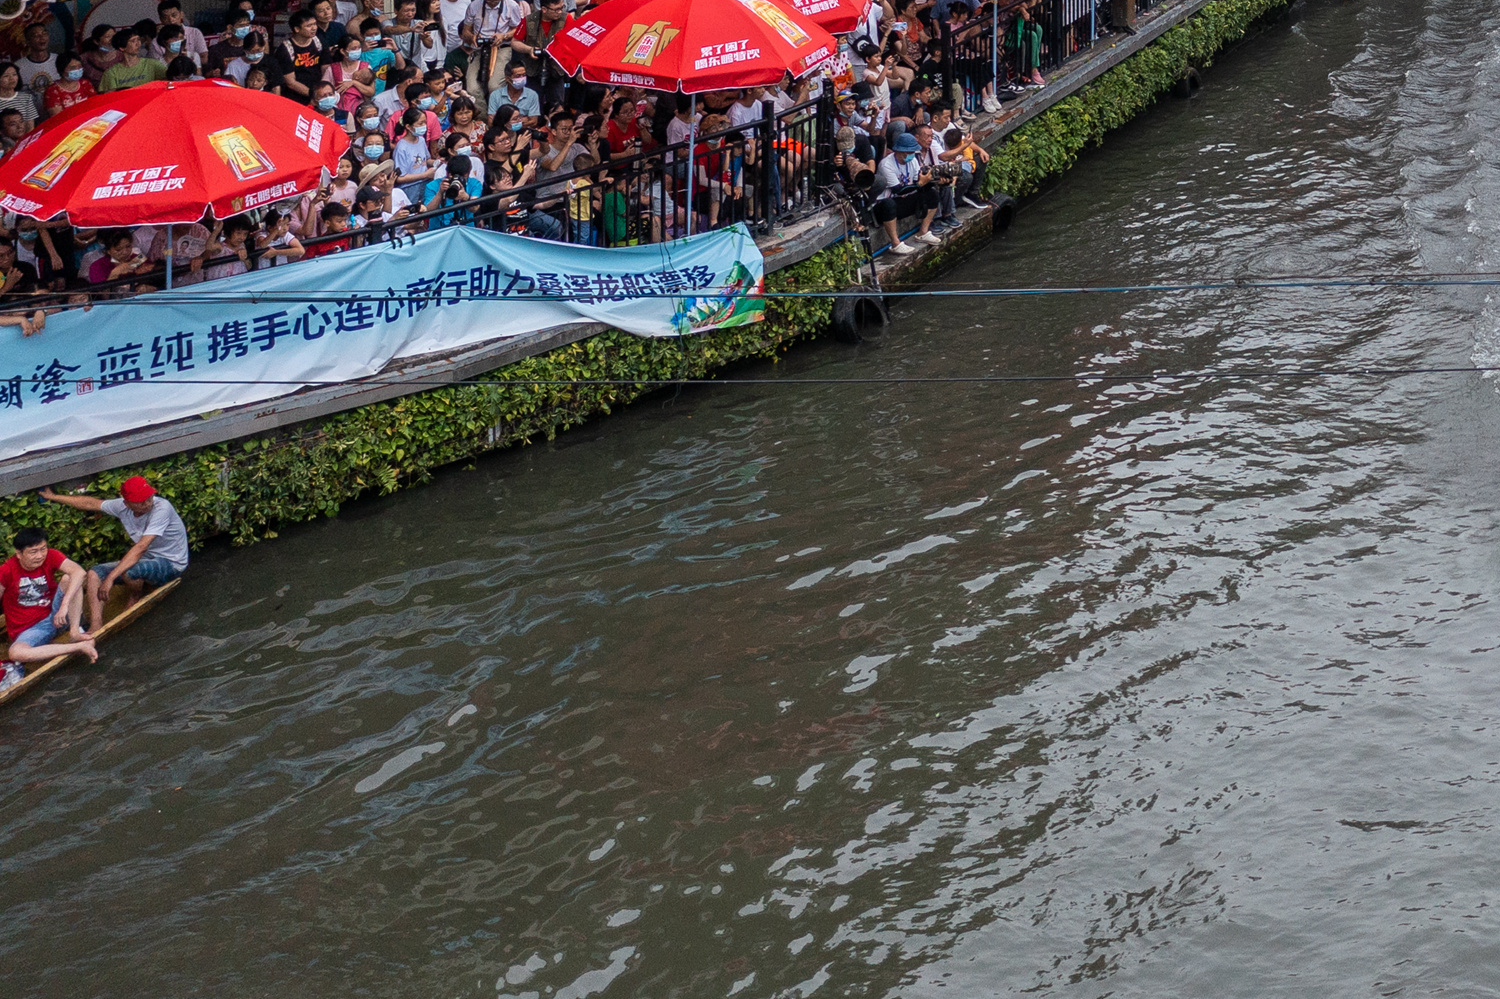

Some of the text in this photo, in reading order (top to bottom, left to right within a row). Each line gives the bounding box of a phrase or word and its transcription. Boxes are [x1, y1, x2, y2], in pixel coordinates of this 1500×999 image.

[694, 48, 761, 71] 喝东鹏特饮
[700, 39, 750, 58] 累了困了
[609, 71, 656, 87] 东鹏特饮
[107, 164, 179, 184] 累了困了
[91, 177, 187, 200] 喝东鹏特饮
[244, 180, 298, 208] 东鹏特饮
[97, 331, 195, 391] 蓝纯
